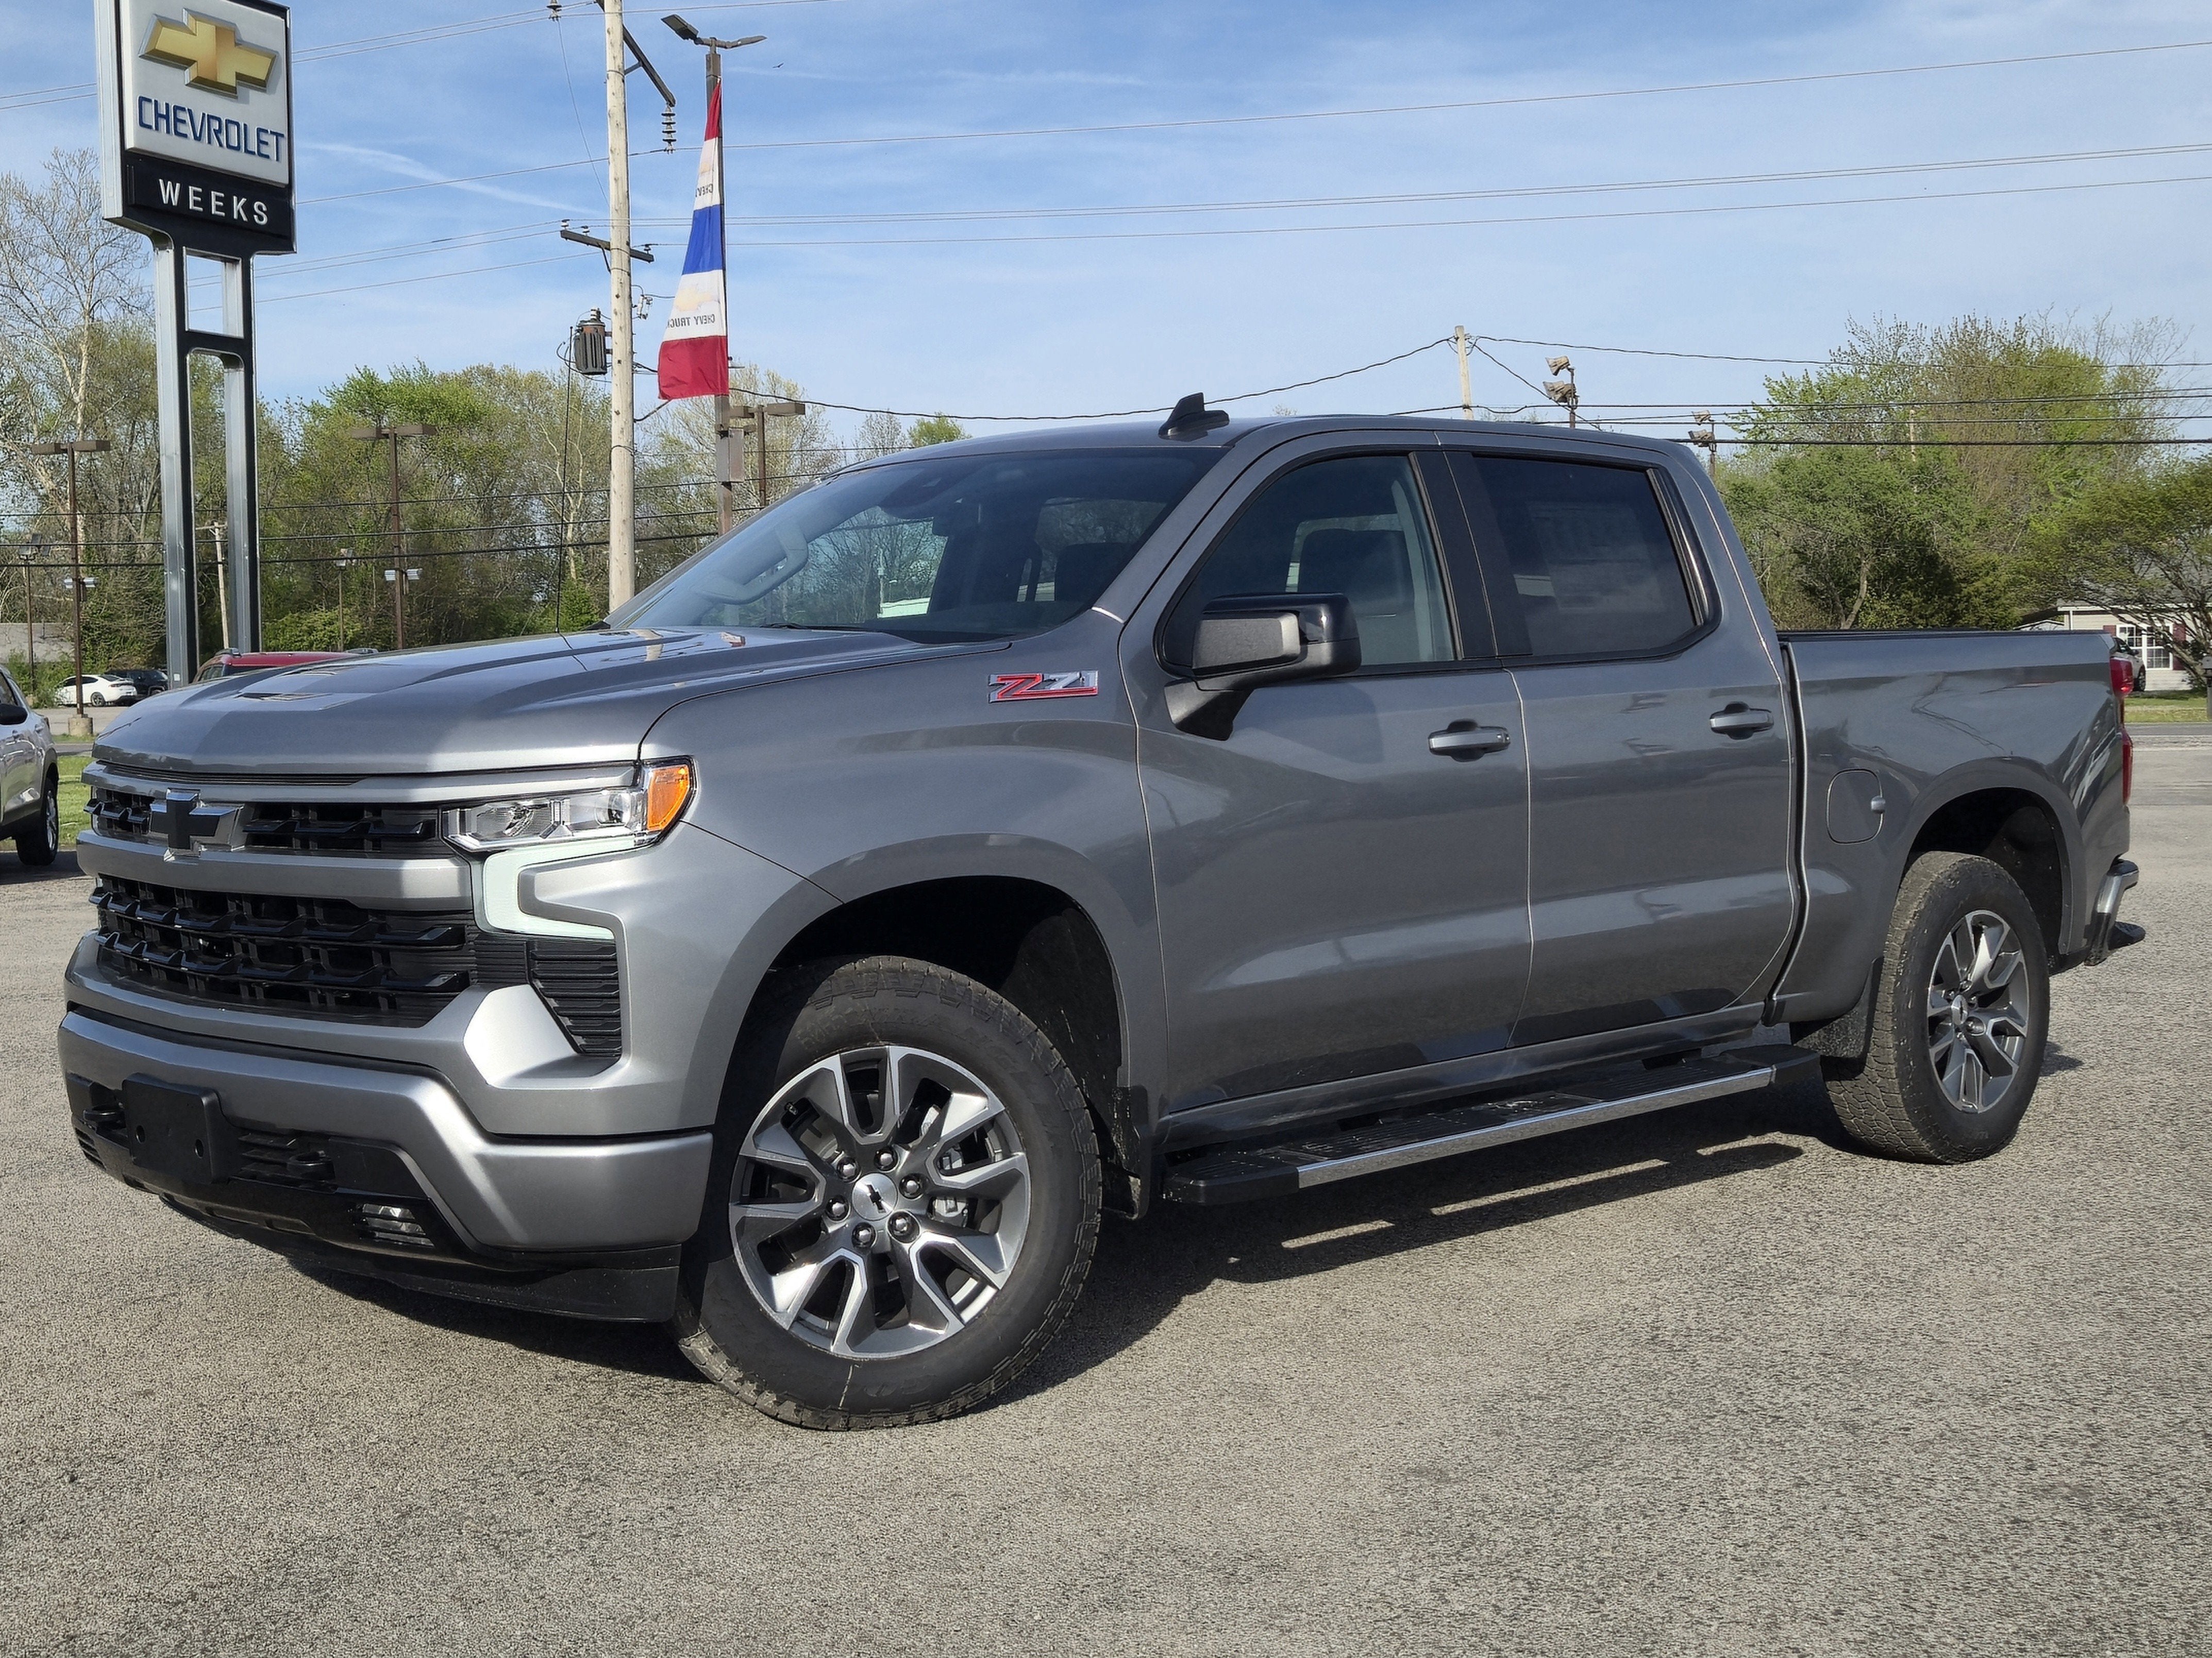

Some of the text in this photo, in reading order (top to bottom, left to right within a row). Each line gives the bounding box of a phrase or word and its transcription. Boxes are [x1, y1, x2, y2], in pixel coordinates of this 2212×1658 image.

[138, 95, 284, 162] CHEVROLET
[158, 178, 269, 226] WEEKS
[988, 670, 1098, 703] Z71
